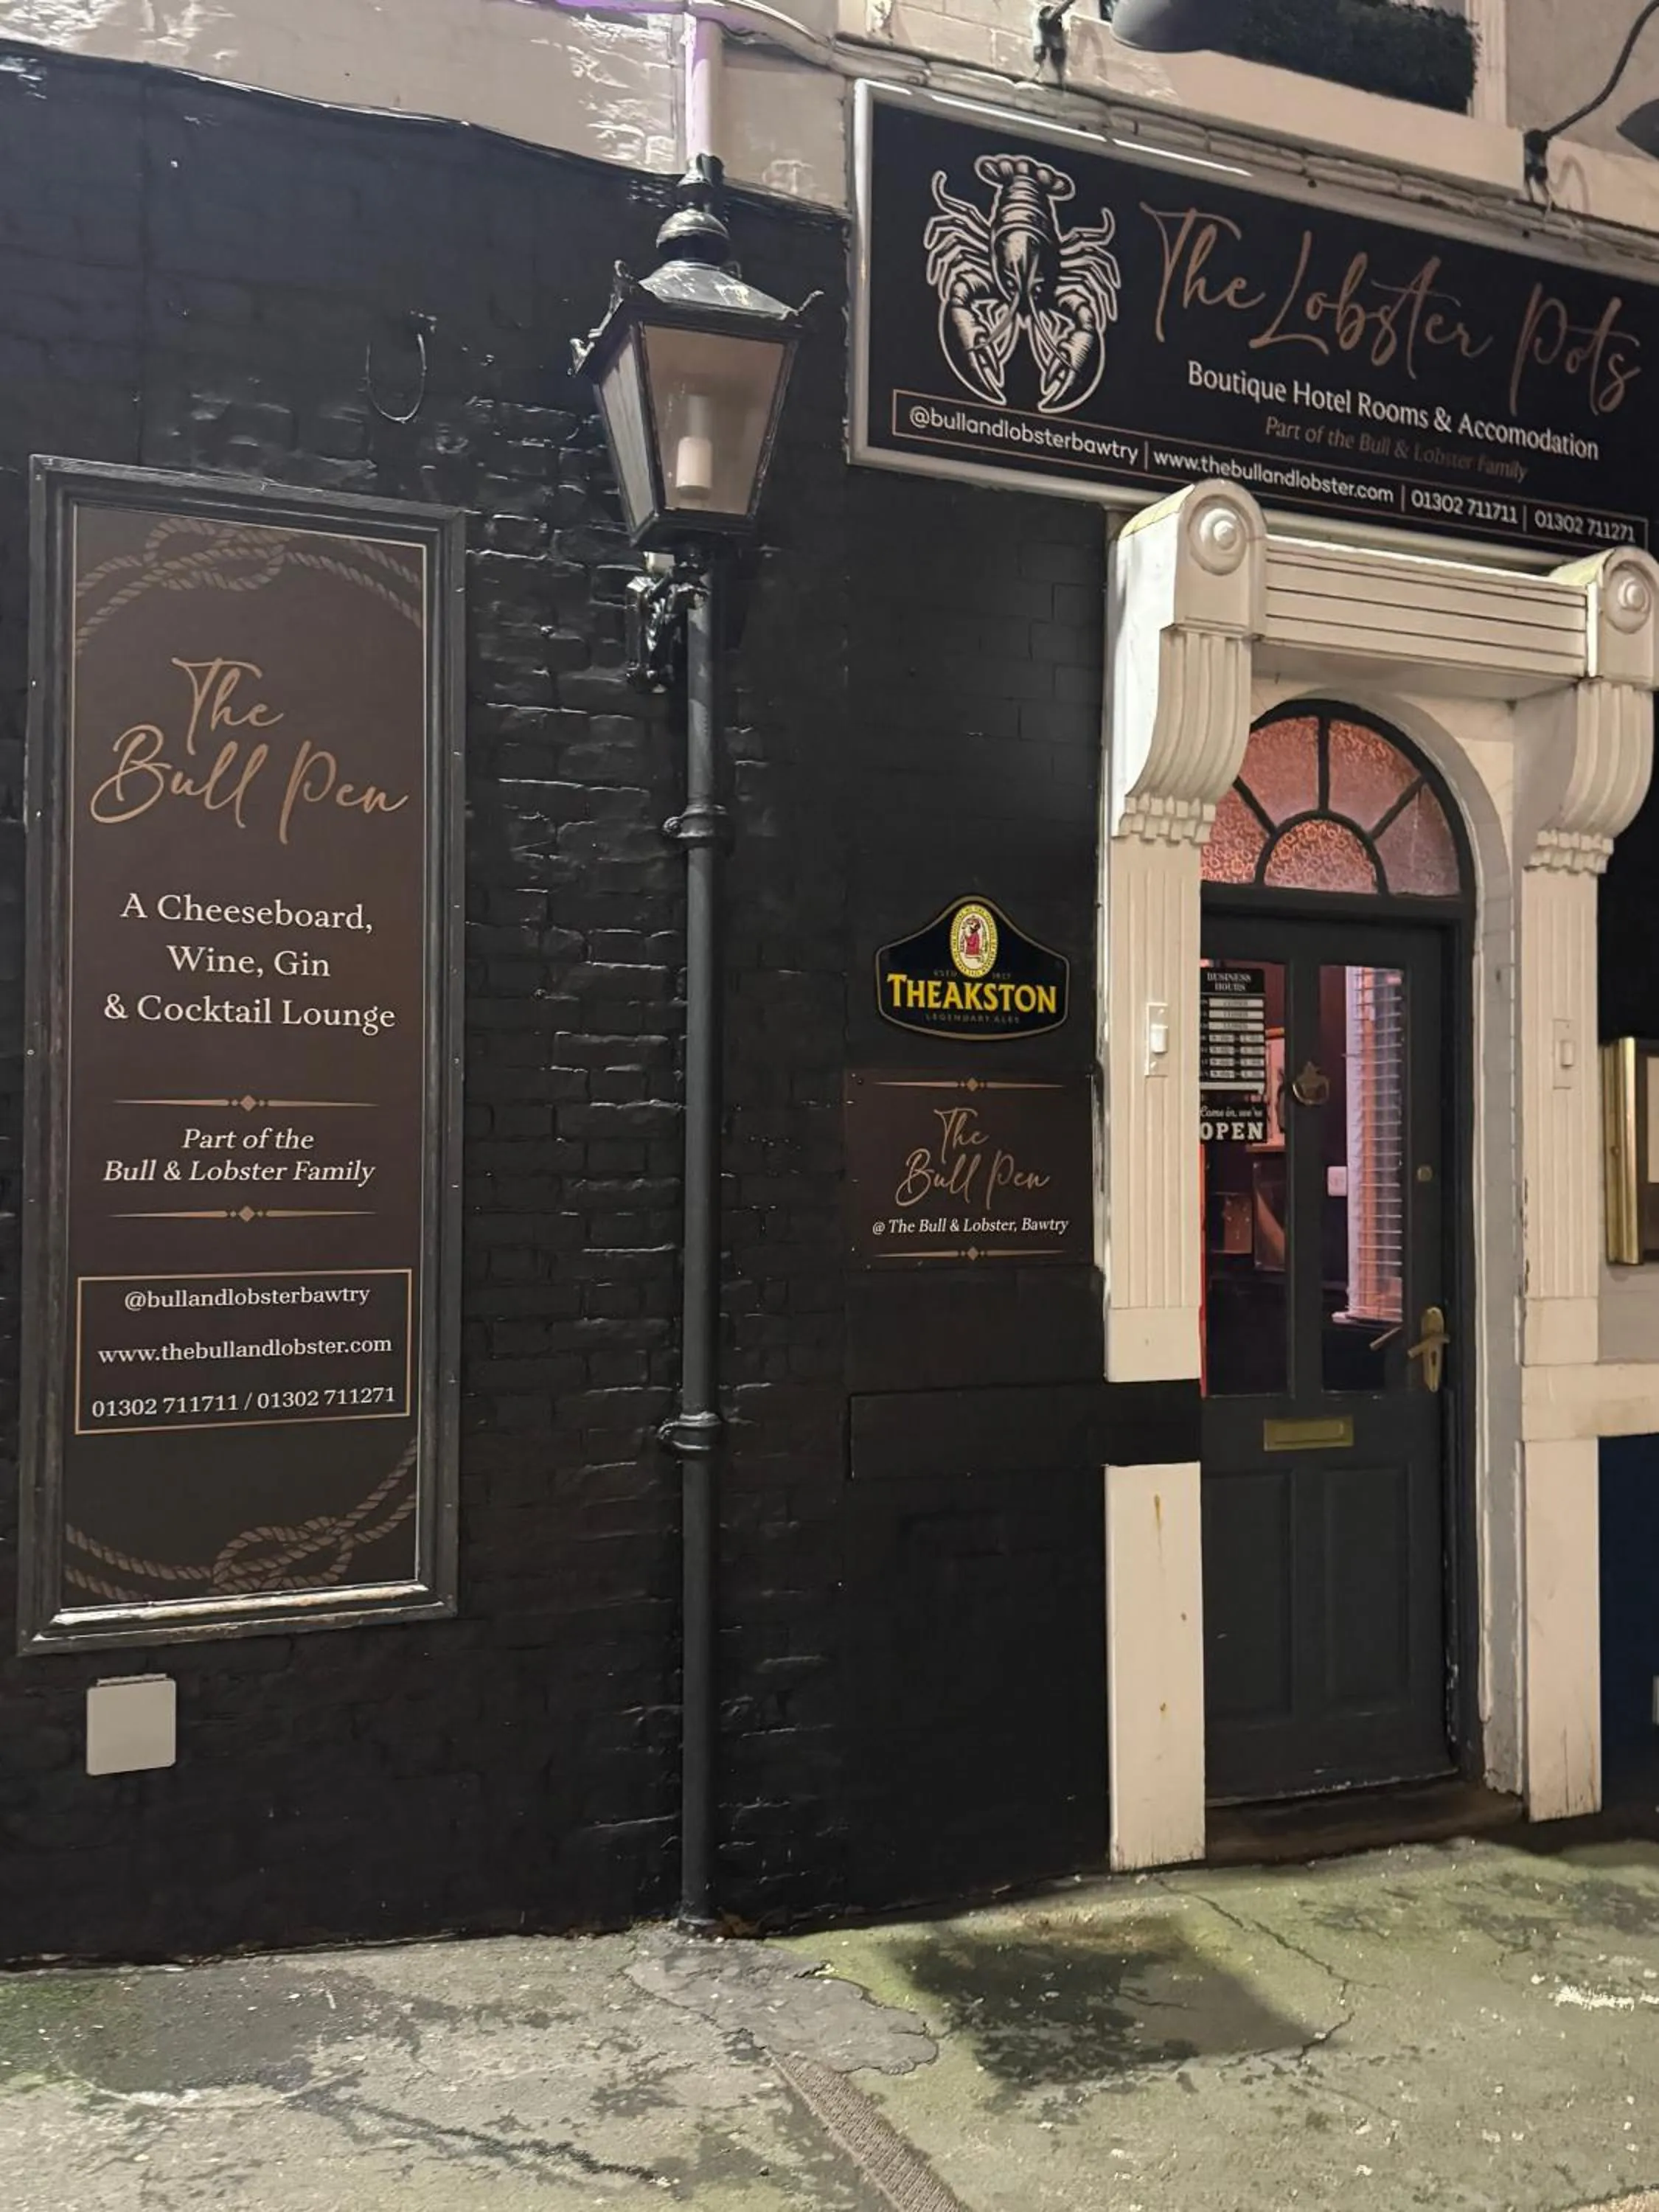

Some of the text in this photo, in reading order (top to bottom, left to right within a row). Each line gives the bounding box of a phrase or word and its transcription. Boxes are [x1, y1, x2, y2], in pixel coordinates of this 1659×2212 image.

[1140, 201, 1642, 417] The Lobster Pots
[1188, 360, 1599, 461] Boutique Hotel Rooms & Accomodation
[1265, 415, 1528, 484] Part of the Bull & Lobster Family
[909, 406, 1636, 543] @bullandlobsterbawtry www.thebullandlobster.com 01302 711711 01302 711271
[172, 657, 284, 756] The
[91, 724, 409, 844] Bull Pen
[119, 893, 373, 935] A Cheeseboard,
[167, 945, 331, 978] Wine, Gin
[1207, 973, 1251, 982] BUSINESS
[886, 973, 1057, 1014] THEAKSTON
[1214, 982, 1246, 991] HOURS
[104, 993, 396, 1036] & Cocktail Lounge
[925, 1012, 1020, 1024] LEGENDARY ALES
[1201, 1105, 1225, 1117] Come
[182, 1127, 314, 1150] Part of the
[933, 1107, 990, 1165] The
[1201, 1121, 1263, 1141] OPEN
[104, 1160, 376, 1188] Bull & Lobster Family
[894, 1148, 1050, 1210] Bull Pen
[872, 1217, 1068, 1235] @ The Bull & Lobster, Bawtry
[124, 1287, 370, 1312] @bullandlobsterbawtry
[97, 1336, 392, 1364] www.thebullandlobster.com
[91, 1385, 395, 1418] 01302 711711 / 01302 711271
